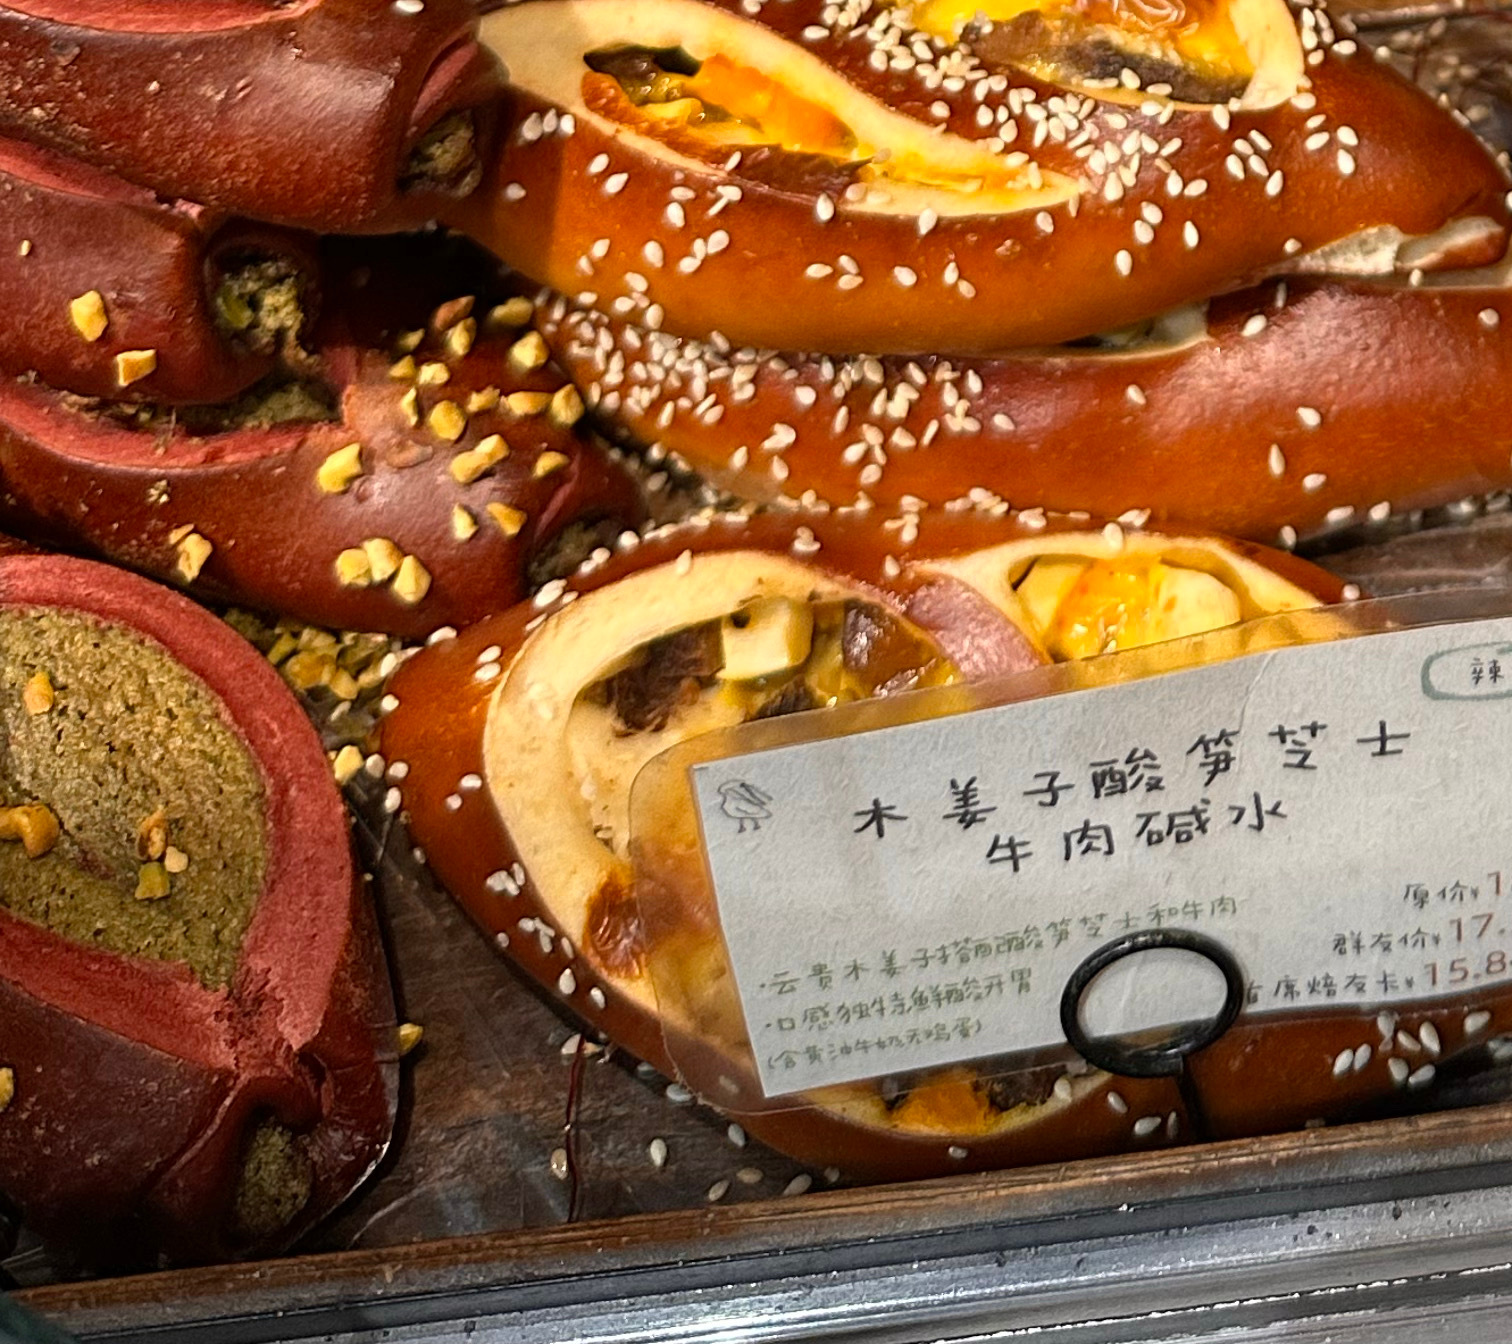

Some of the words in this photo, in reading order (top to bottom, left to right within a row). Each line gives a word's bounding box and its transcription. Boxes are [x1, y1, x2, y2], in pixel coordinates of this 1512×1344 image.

[1468, 656, 1506, 686] 辣
[852, 719, 1412, 839] 木姜子酸笋芝士
[985, 791, 1288, 873] 牛肉碱水
